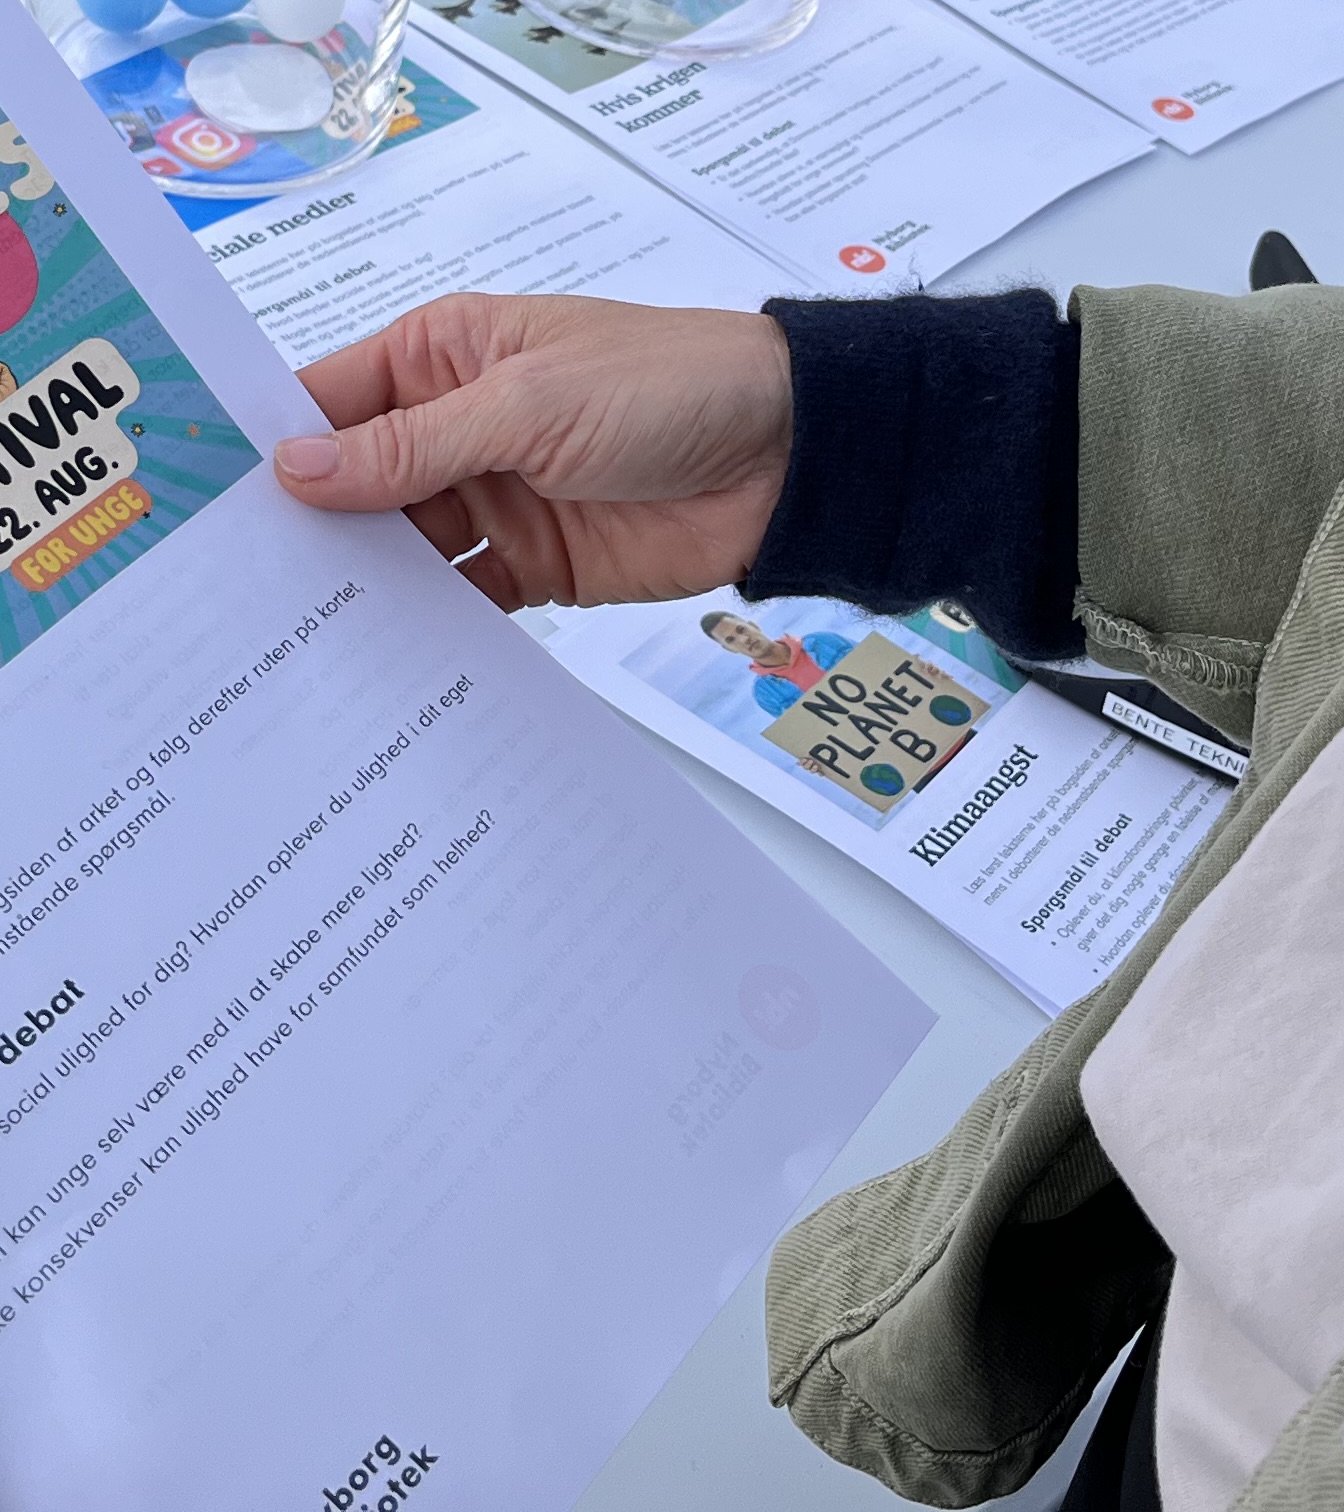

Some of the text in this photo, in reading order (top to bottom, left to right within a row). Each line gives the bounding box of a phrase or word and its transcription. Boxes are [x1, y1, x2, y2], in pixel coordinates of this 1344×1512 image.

[589, 61, 707, 117] Hvis krigen
[615, 89, 704, 133] kommer
[265, 191, 358, 238] medier
[334, 260, 377, 284] debat
[33, 447, 120, 513] AUG.
[20, 486, 145, 585] FOR UNGE
[56, 826, 78, 852] af
[79, 787, 126, 832] arket
[125, 766, 154, 791] og
[148, 734, 190, 767] følg
[188, 674, 252, 735] derefter
[252, 639, 295, 678] ruten
[294, 615, 319, 644] på
[314, 580, 365, 619] kortet,
[801, 672, 870, 728] NO
[808, 659, 933, 779] PLANET
[1112, 701, 1176, 742] BENTE
[889, 729, 938, 763] B
[79, 789, 175, 877] spørgsmål.
[908, 742, 1041, 868] Klimaangst
[54, 1005, 125, 1077] ulighed
[121, 981, 152, 1011] for
[154, 940, 192, 982] dig?
[189, 874, 266, 945] Hvordan
[267, 812, 328, 874] oplever
[329, 790, 352, 814] du
[351, 730, 410, 791] ulighed
[405, 722, 419, 735] i
[418, 703, 441, 727] dit
[439, 673, 473, 707] eget
[1021, 814, 1131, 932] Spørgsmål til debat
[2, 1205, 46, 1244] kan
[46, 1153, 96, 1203] unge
[97, 1112, 135, 1153] selv
[135, 1064, 185, 1112] være
[186, 1016, 229, 1064] med
[225, 997, 249, 1021] til
[249, 977, 271, 1001] at
[269, 929, 321, 981] skabe
[321, 885, 365, 929] mere
[360, 822, 422, 885] lighed?
[12, 1171, 142, 1303] konsekvenser
[139, 1136, 182, 1173] kan
[180, 1062, 249, 1135] ulighed
[243, 1022, 292, 1067] have
[289, 992, 318, 1021] for
[318, 906, 403, 995] samfundet
[401, 873, 438, 909] som
[432, 809, 495, 874] helhed?
